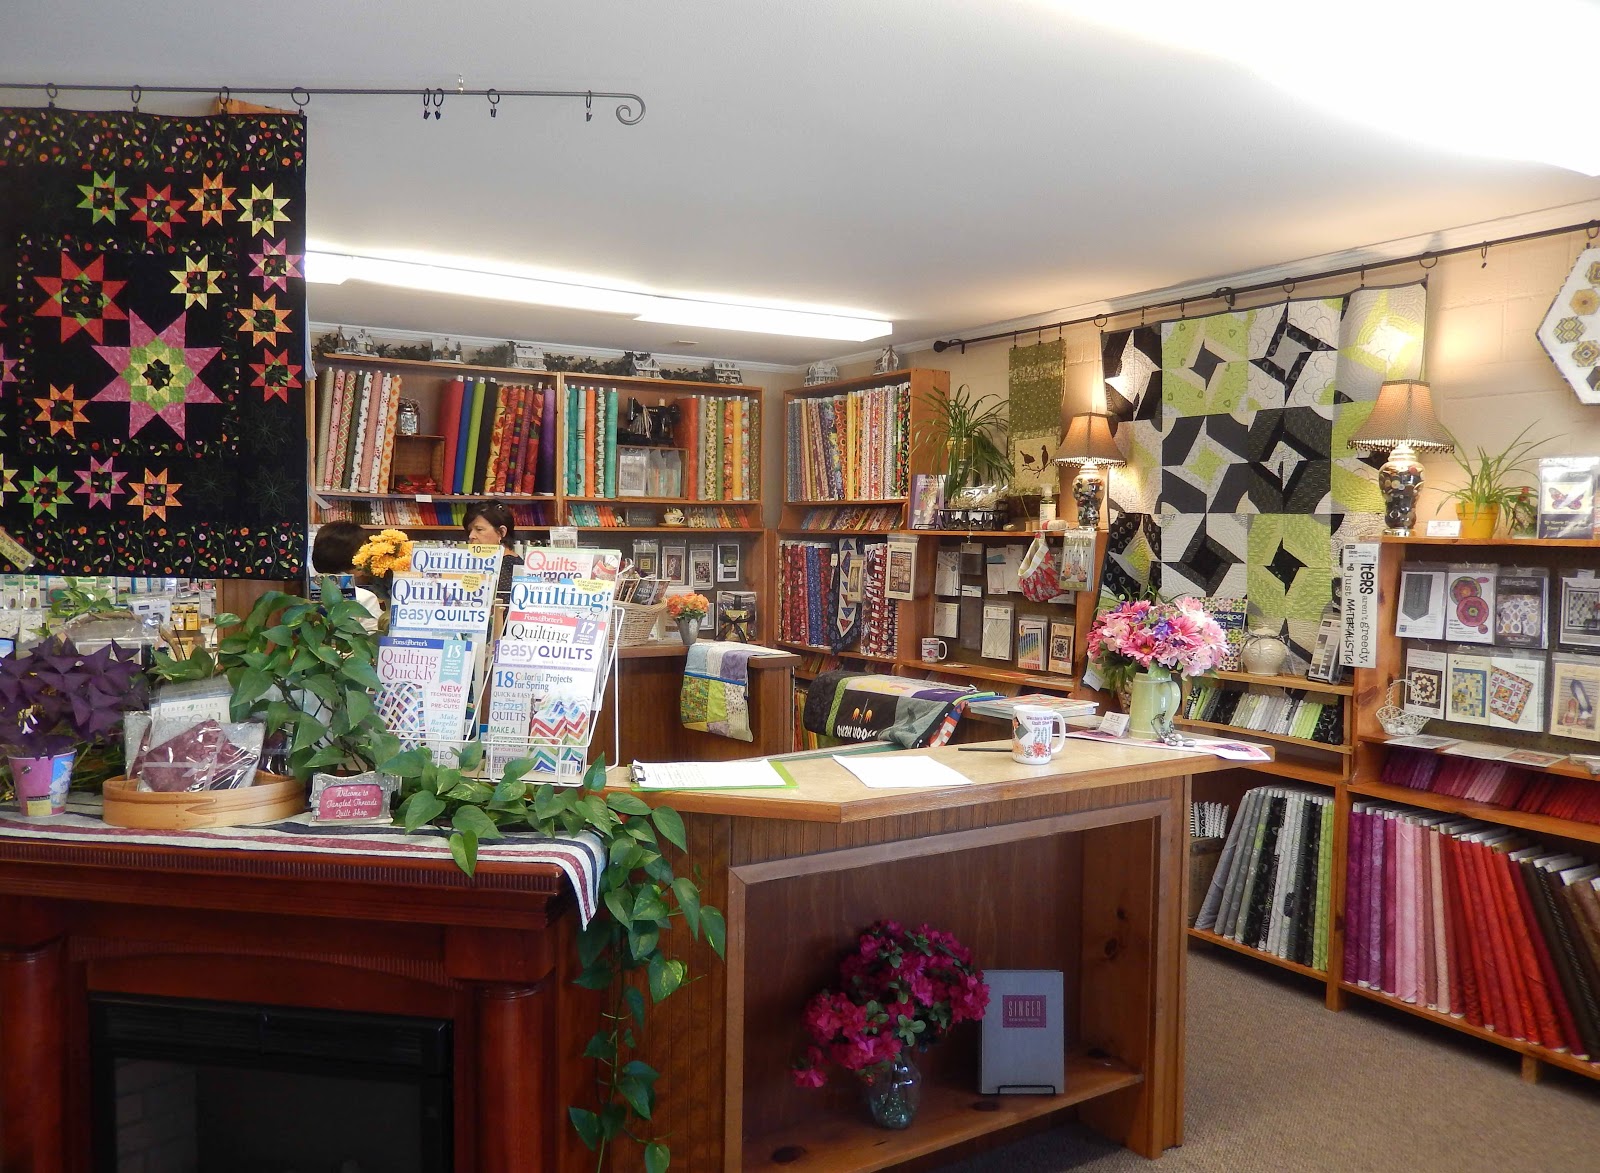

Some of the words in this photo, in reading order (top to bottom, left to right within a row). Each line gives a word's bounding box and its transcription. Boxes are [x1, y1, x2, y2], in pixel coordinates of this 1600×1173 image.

[472, 546, 480, 554] 10
[412, 550, 497, 575] Quilting
[526, 550, 578, 572] Quilts
[543, 572, 582, 580] more
[1344, 573, 1354, 596] just
[1360, 563, 1374, 595] lteRS
[392, 579, 485, 608] Quilting
[510, 584, 604, 613] Quilting
[398, 608, 434, 626] easy
[434, 609, 485, 622] QUILTS
[511, 624, 570, 643] Quilting
[580, 622, 596, 634] 17
[446, 644, 462, 658] 18
[1360, 620, 1371, 664] greedy,
[381, 648, 439, 670] Quilting
[501, 644, 537, 662] easy
[538, 645, 593, 660] QUILTS
[382, 664, 436, 684] Quickly
[495, 670, 514, 688] 18
[515, 672, 545, 682] Colorful
[545, 674, 573, 685] Projects
[514, 680, 525, 689] for
[526, 681, 549, 692] Spring
[492, 711, 526, 722] QUILTS
[336, 789, 362, 797] Welcome
[326, 799, 352, 809] Tangled
[353, 798, 378, 806] Threads
[336, 810, 350, 818] Quilt
[352, 808, 368, 817] Shop
[1008, 1000, 1040, 1017] SINGER
